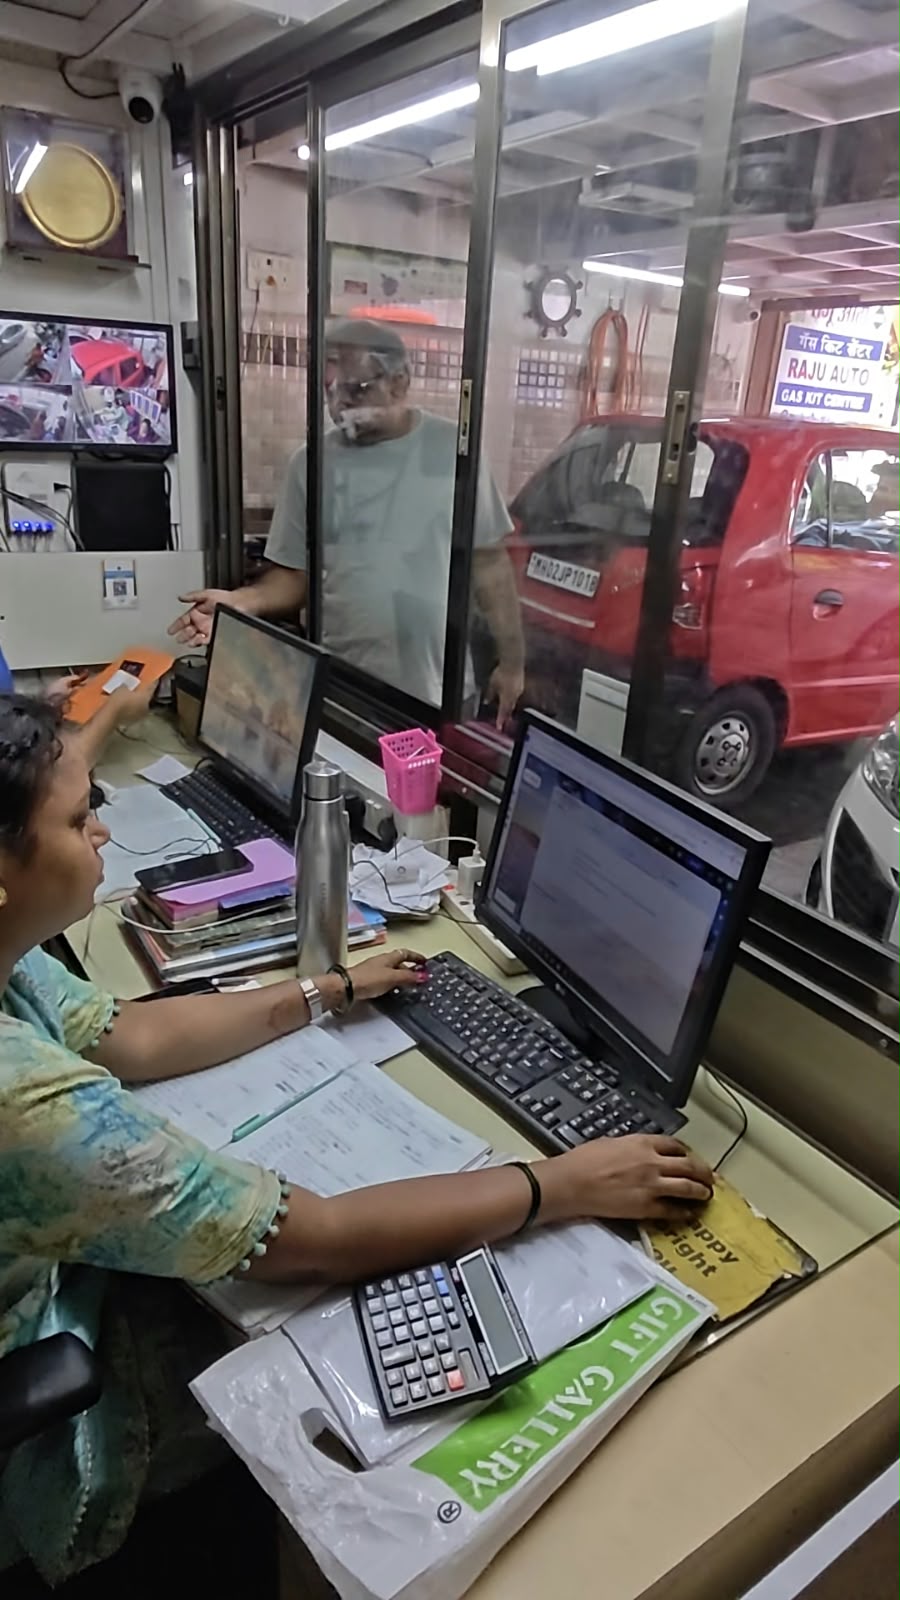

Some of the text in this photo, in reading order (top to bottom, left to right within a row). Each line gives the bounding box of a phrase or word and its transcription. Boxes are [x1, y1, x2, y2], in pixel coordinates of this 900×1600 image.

[787, 358, 870, 386] RAJU AUTO
[781, 389, 804, 403] GAS
[804, 391, 824, 406] KIT
[610, 1296, 683, 1362] GIFT
[459, 1365, 615, 1499] GALLERY
